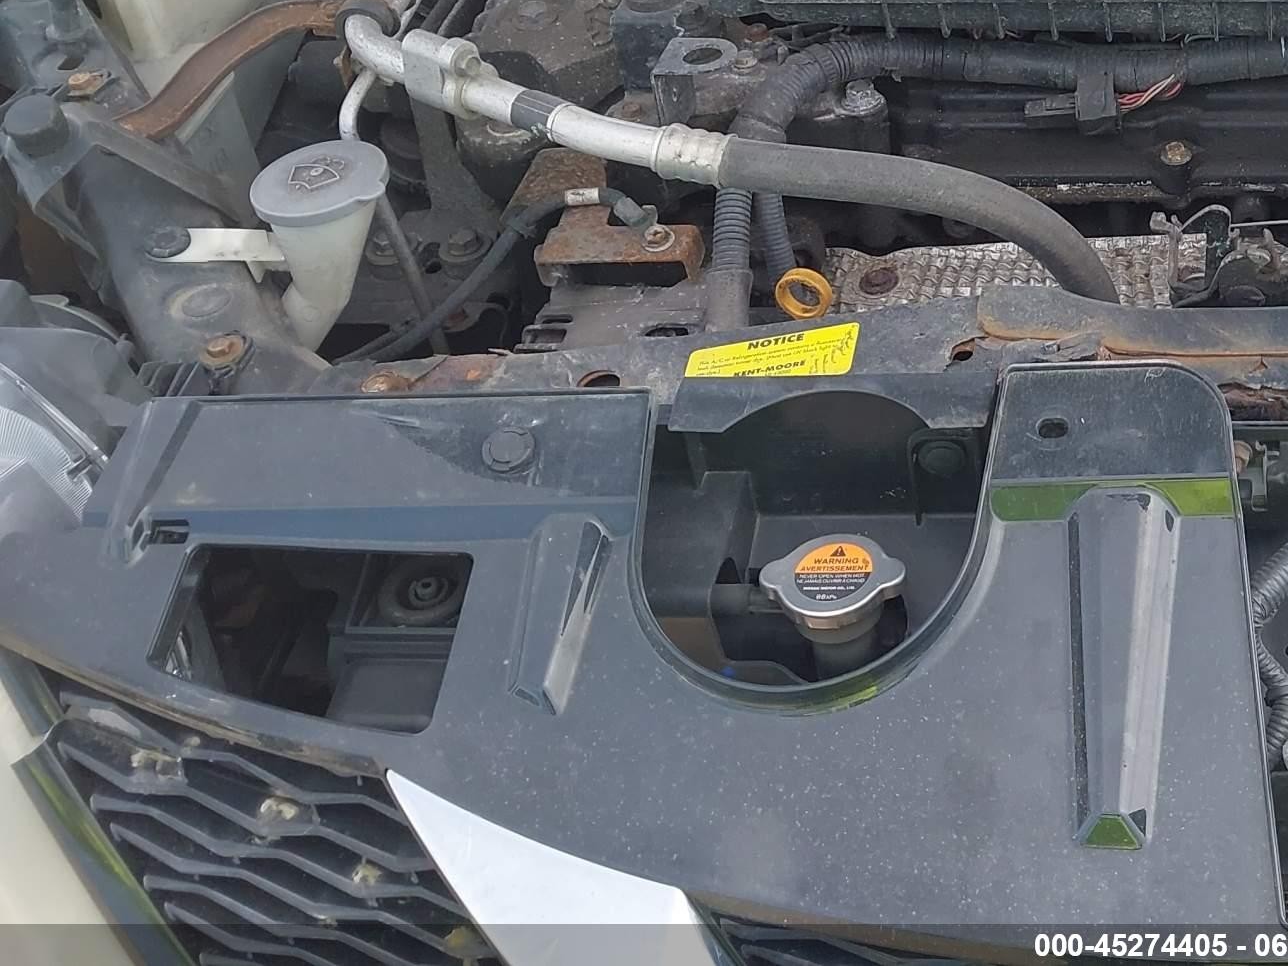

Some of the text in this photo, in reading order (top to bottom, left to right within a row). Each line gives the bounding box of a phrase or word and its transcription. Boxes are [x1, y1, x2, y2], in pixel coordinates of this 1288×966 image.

[747, 334, 805, 350] NOTICE
[733, 361, 806, 376] KENT-MOORE
[814, 557, 859, 565] WARNING
